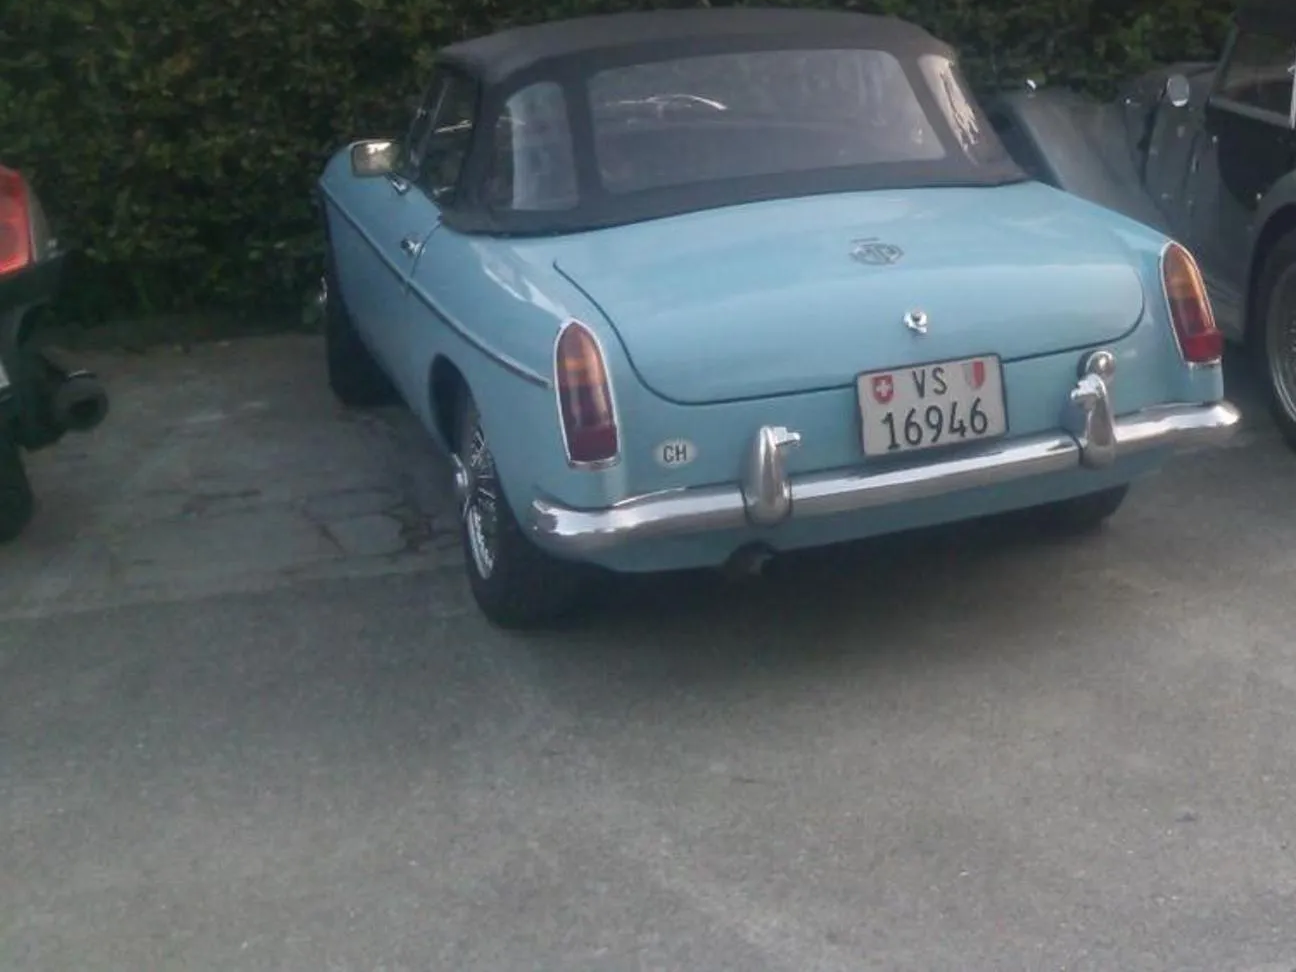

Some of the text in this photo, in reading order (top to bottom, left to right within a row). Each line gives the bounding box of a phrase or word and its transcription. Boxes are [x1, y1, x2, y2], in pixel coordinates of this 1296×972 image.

[911, 367, 948, 399] VS
[881, 397, 988, 449] 16946
[662, 444, 687, 463] CH
